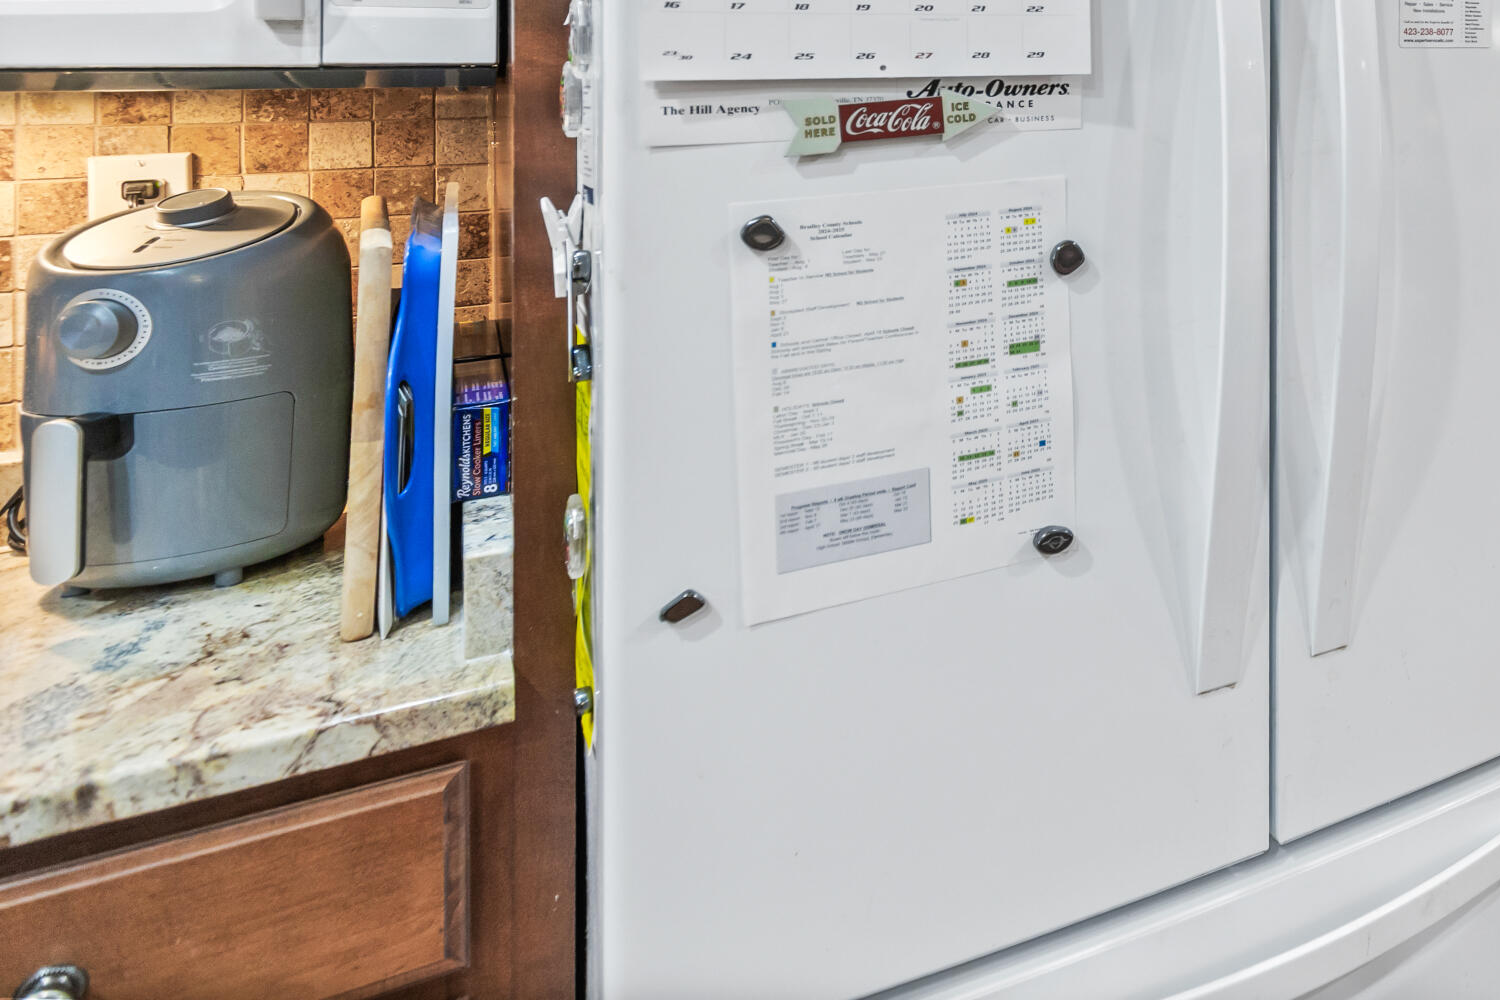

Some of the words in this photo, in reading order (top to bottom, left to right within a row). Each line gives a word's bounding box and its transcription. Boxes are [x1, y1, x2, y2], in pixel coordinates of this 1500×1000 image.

[664, 1, 680, 9] 16
[730, 2, 746, 10] 17
[794, 3, 810, 11] 18
[855, 4, 871, 12] 19
[914, 4, 934, 12] 20
[1026, 5, 1044, 13] 22
[794, 52, 815, 60] 25
[856, 52, 876, 60] 26
[914, 52, 933, 60] 27
[972, 51, 990, 59] 28
[1027, 51, 1045, 59] 29
[907, 78, 1068, 99] Ato-Owners
[661, 106, 686, 115] The
[689, 105, 712, 115] Hill
[716, 104, 760, 115] Agency
[951, 101, 970, 112] ICE
[804, 115, 836, 127] SOLD
[846, 102, 934, 136] Coca-Cola
[946, 113, 977, 124] COLD
[987, 116, 1004, 124] CAR
[1015, 114, 1055, 123] BUSINESS
[804, 127, 836, 139] HERE
[463, 414, 472, 454] KITCHENS
[473, 421, 482, 445] Liners
[473, 447, 481, 475] Cooker
[456, 454, 474, 498] Reynolds
[473, 476, 481, 496] Slow
[483, 484, 498, 493] 8
